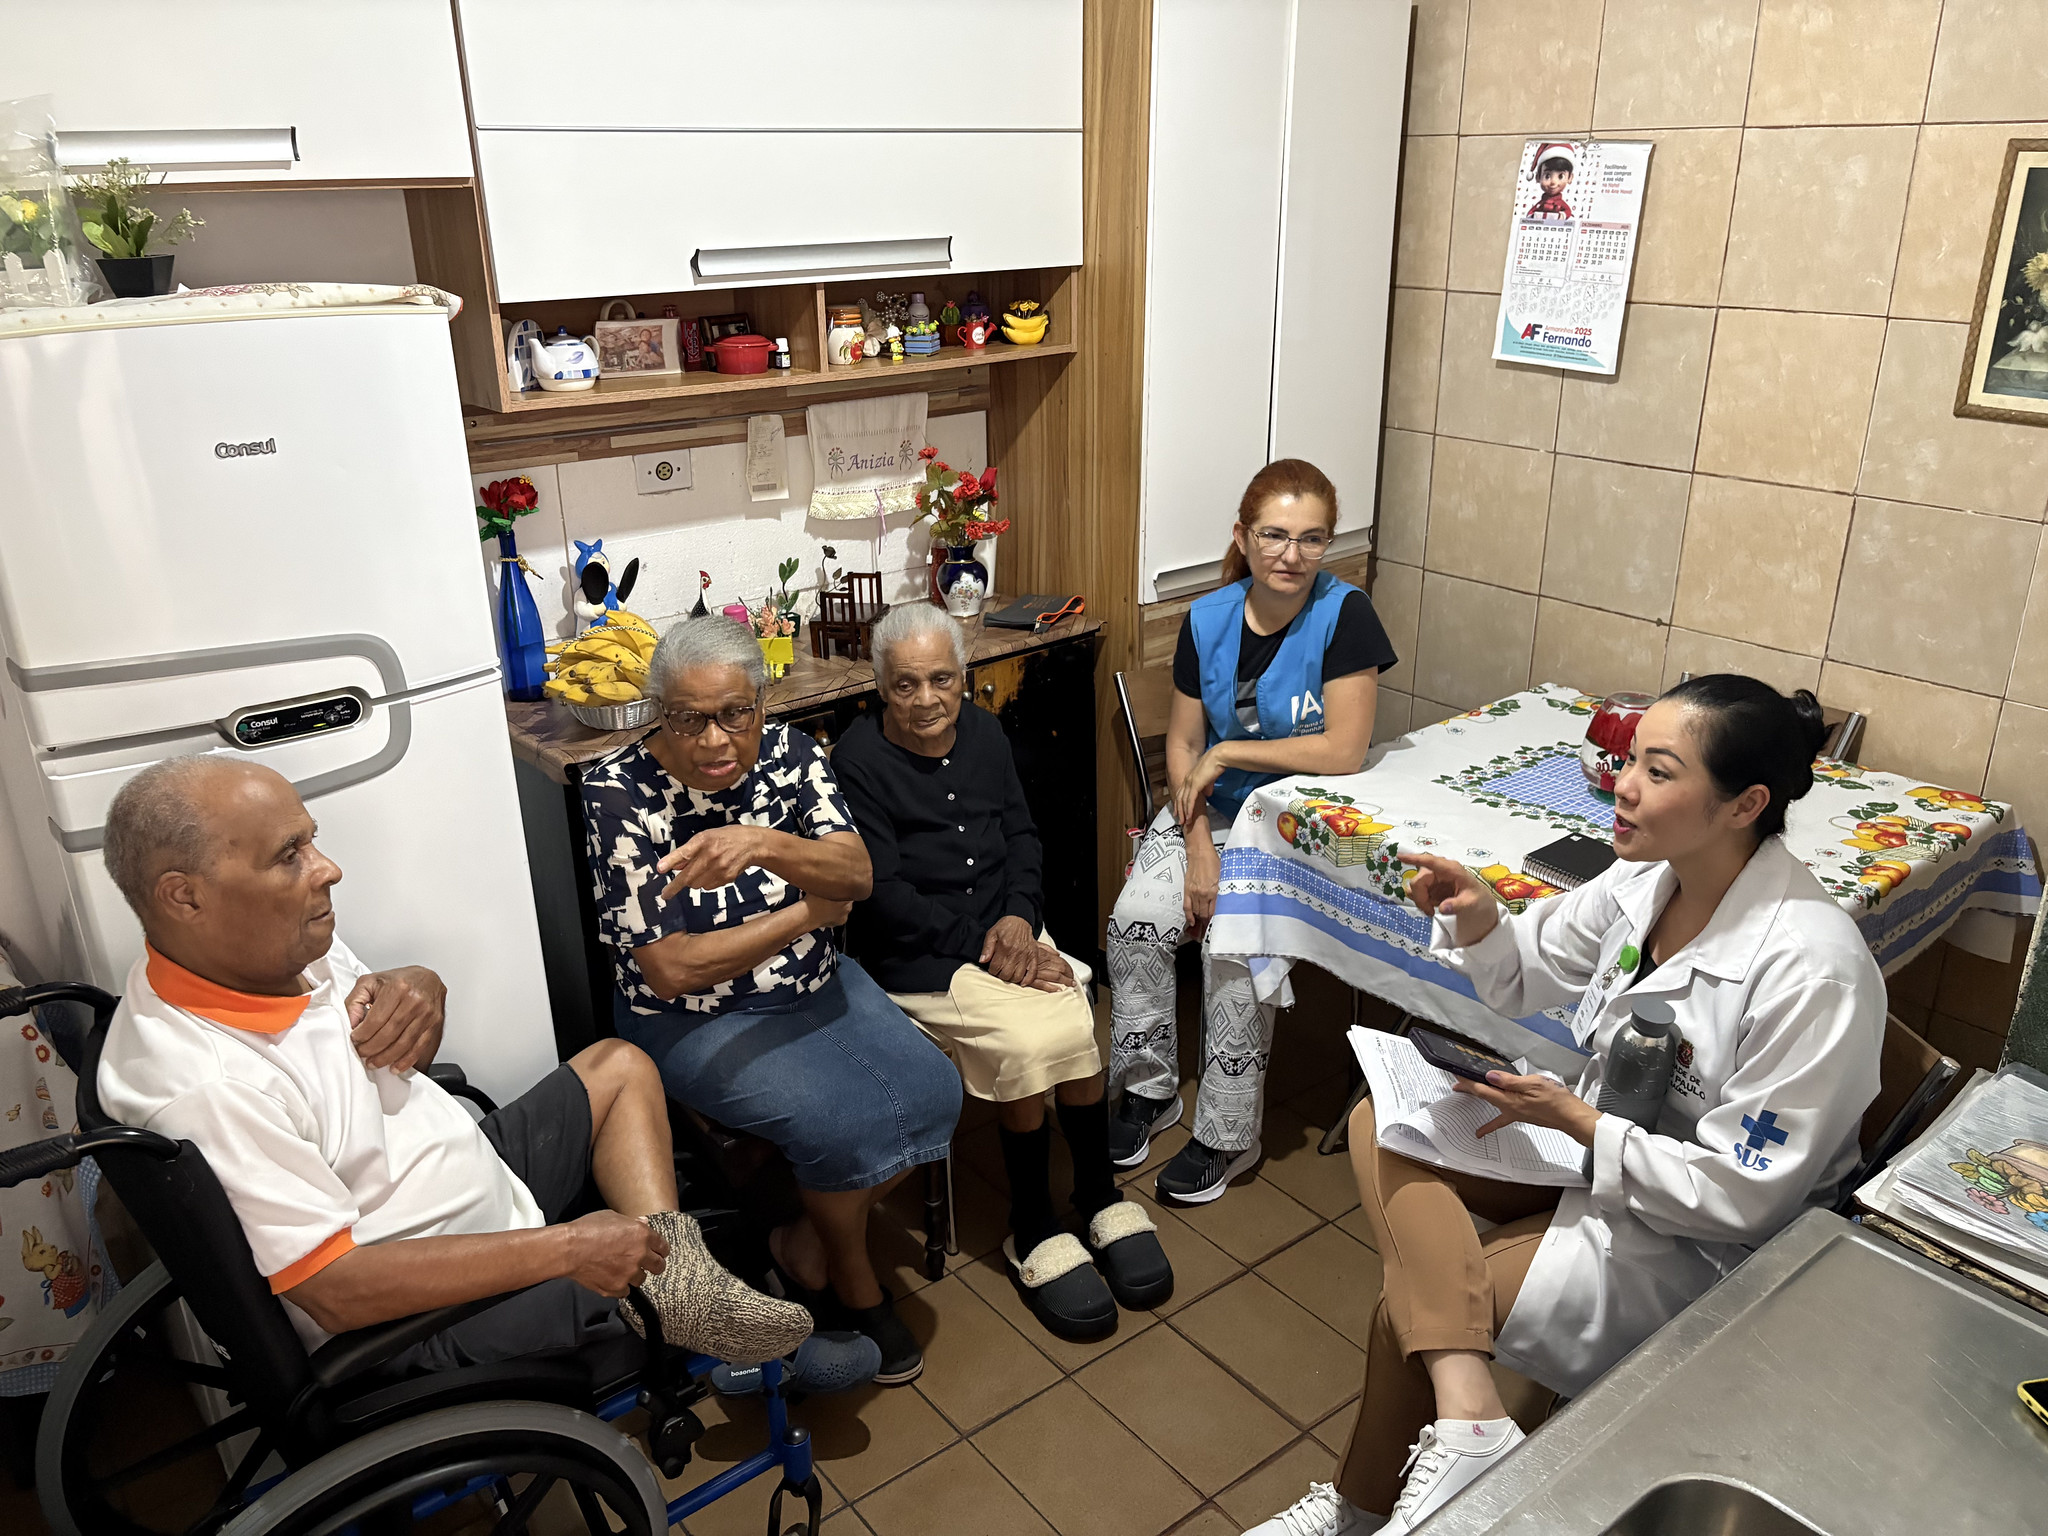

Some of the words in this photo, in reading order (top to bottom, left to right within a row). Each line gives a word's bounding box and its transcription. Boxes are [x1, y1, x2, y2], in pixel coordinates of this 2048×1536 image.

[1521, 323, 1542, 340] AF
[1543, 332, 1591, 347] Fernando
[1545, 325, 1573, 334] Armarinhos
[1574, 327, 1592, 336] 2025
[215, 438, 276, 458] Consul
[847, 452, 894, 471] Anizia
[250, 717, 278, 728] Consul
[1672, 1064, 1688, 1078] ADE
[1689, 1075, 1701, 1086] DE
[1675, 1076, 1705, 1100] PAULO
[1734, 1142, 1772, 1171] SUS
[731, 1368, 759, 1376] boaonda
